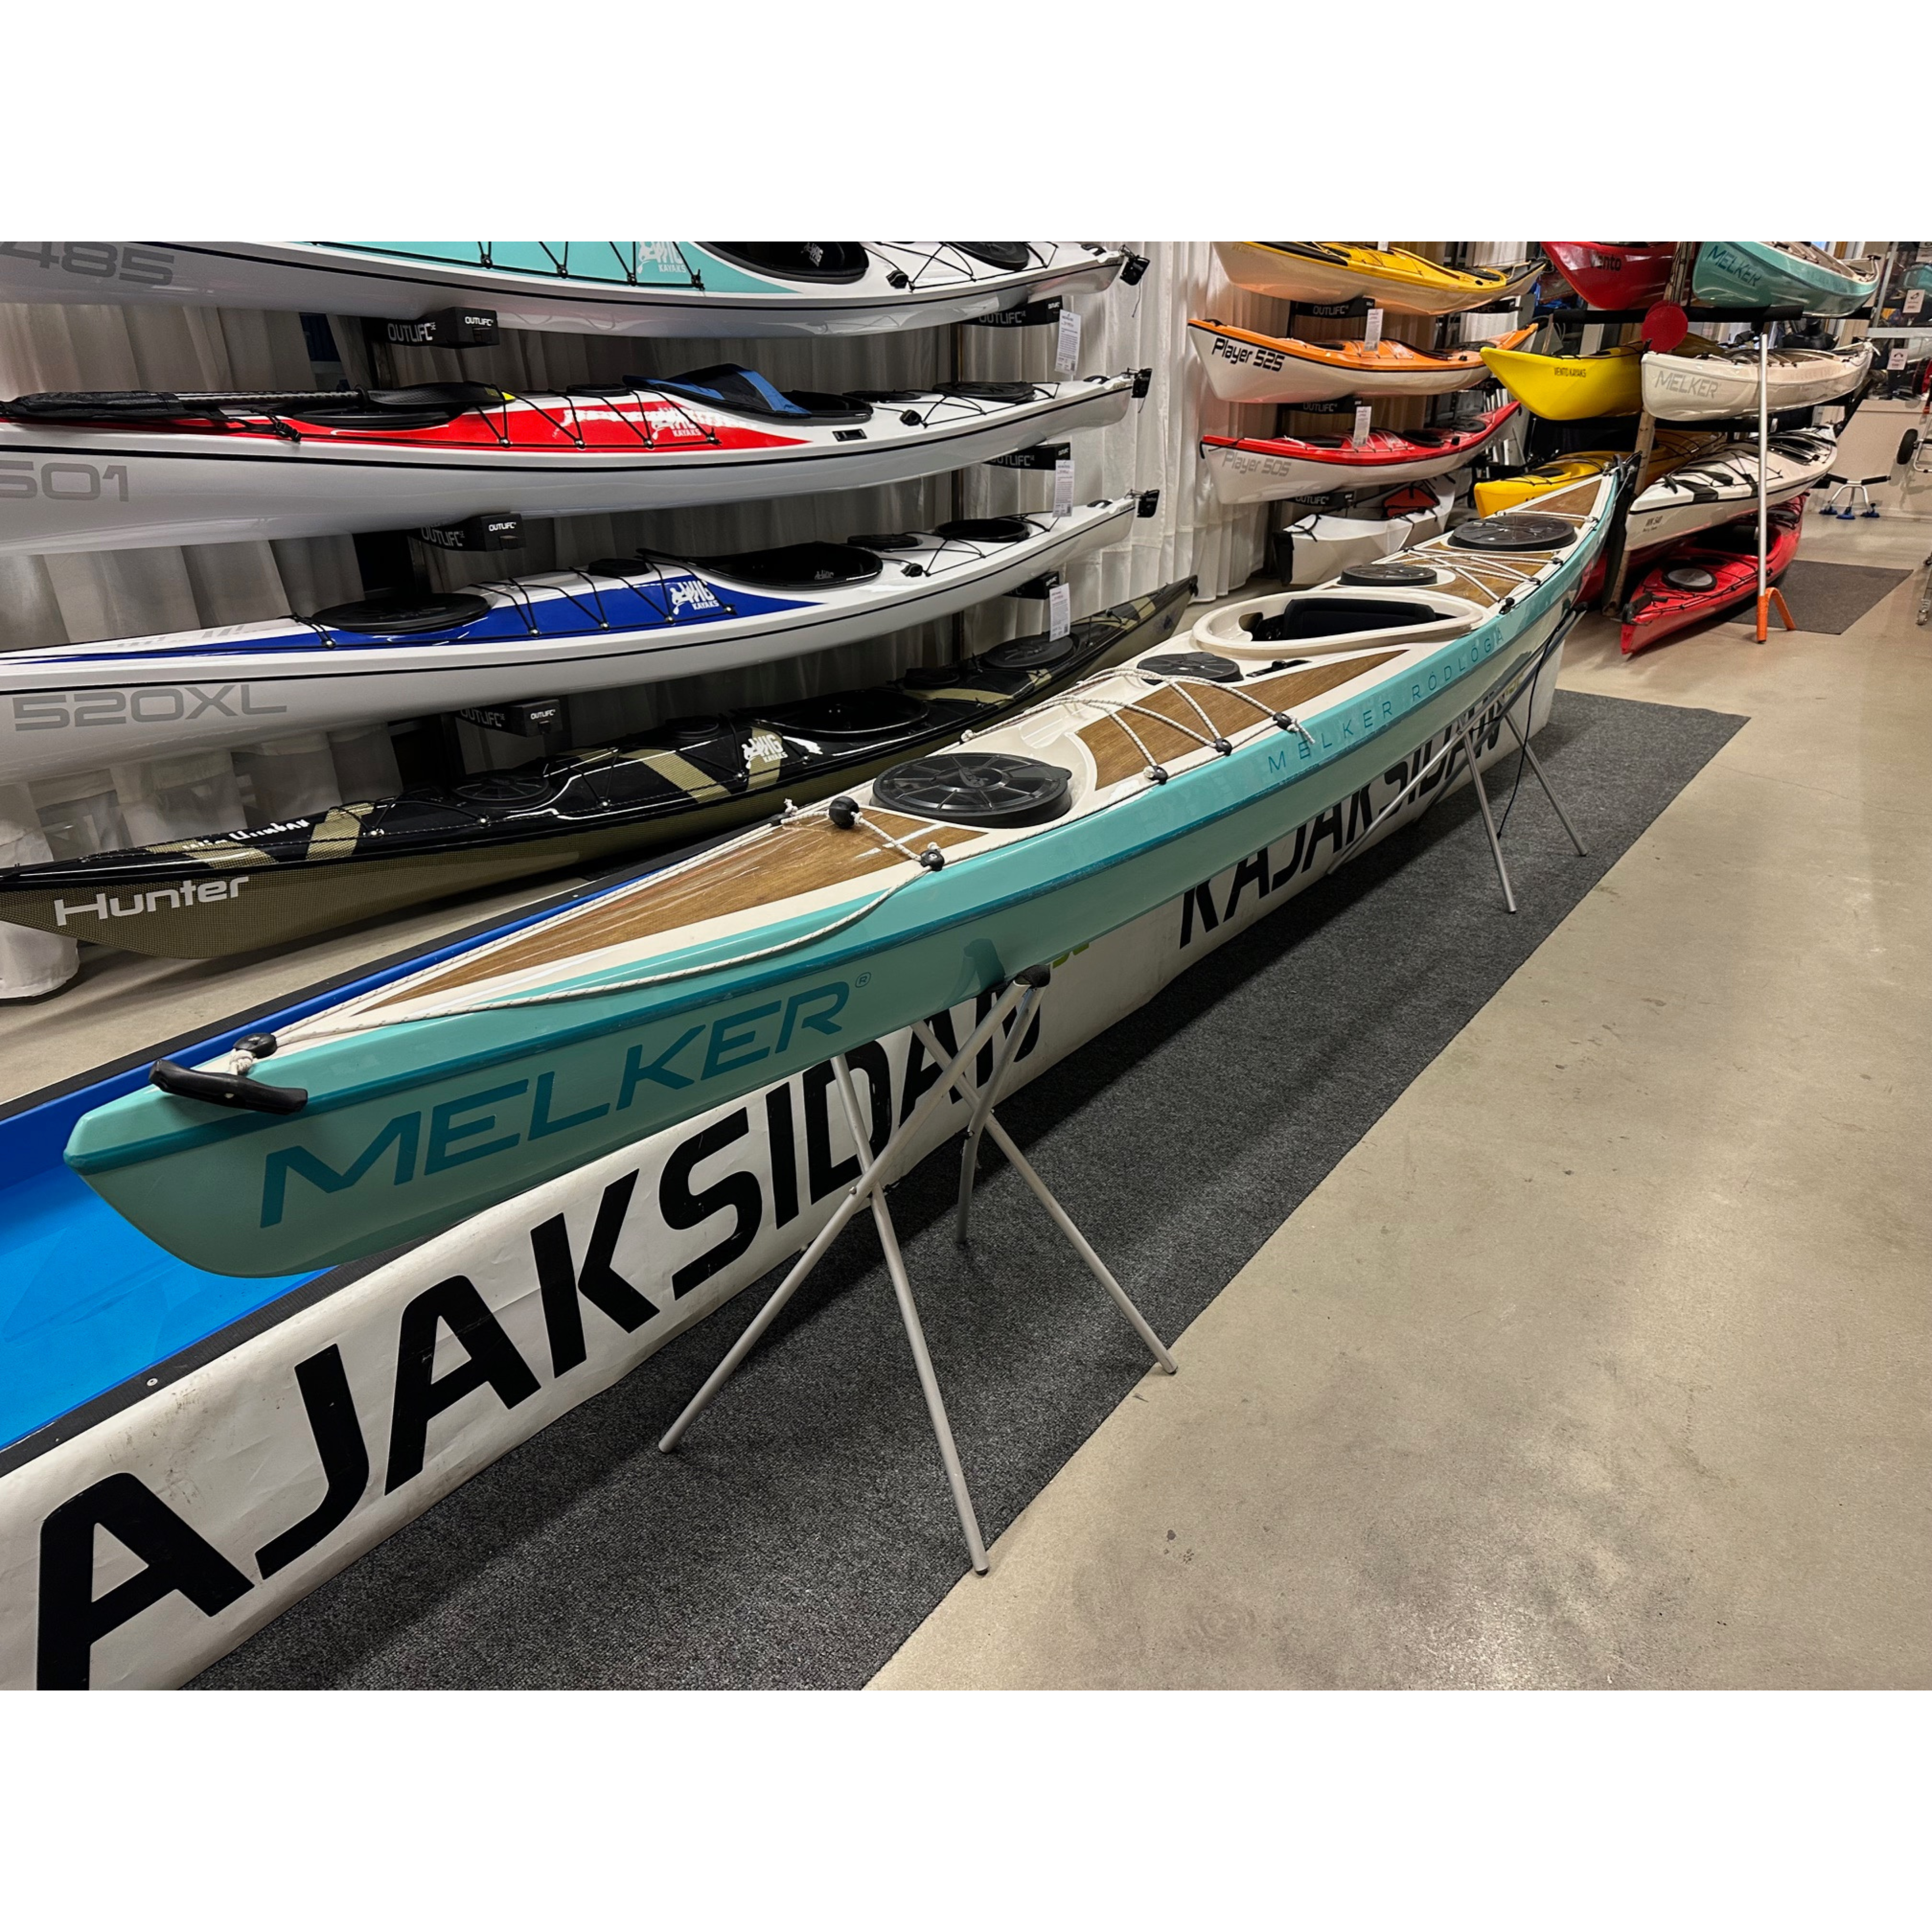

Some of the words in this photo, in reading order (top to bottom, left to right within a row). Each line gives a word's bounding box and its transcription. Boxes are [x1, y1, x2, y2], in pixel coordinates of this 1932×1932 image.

[0, 242, 174, 285] 485
[658, 264, 687, 272] KAYAKS
[1705, 245, 1762, 287] MELKER
[1212, 337, 1253, 365] Player
[1252, 349, 1286, 372] 525
[1655, 370, 1719, 399] MELKER
[1222, 450, 1262, 474] Player
[1261, 457, 1292, 477] 505
[13, 684, 287, 732] 520XL
[1268, 700, 1393, 774] MELKER
[54, 877, 249, 926] Hunter
